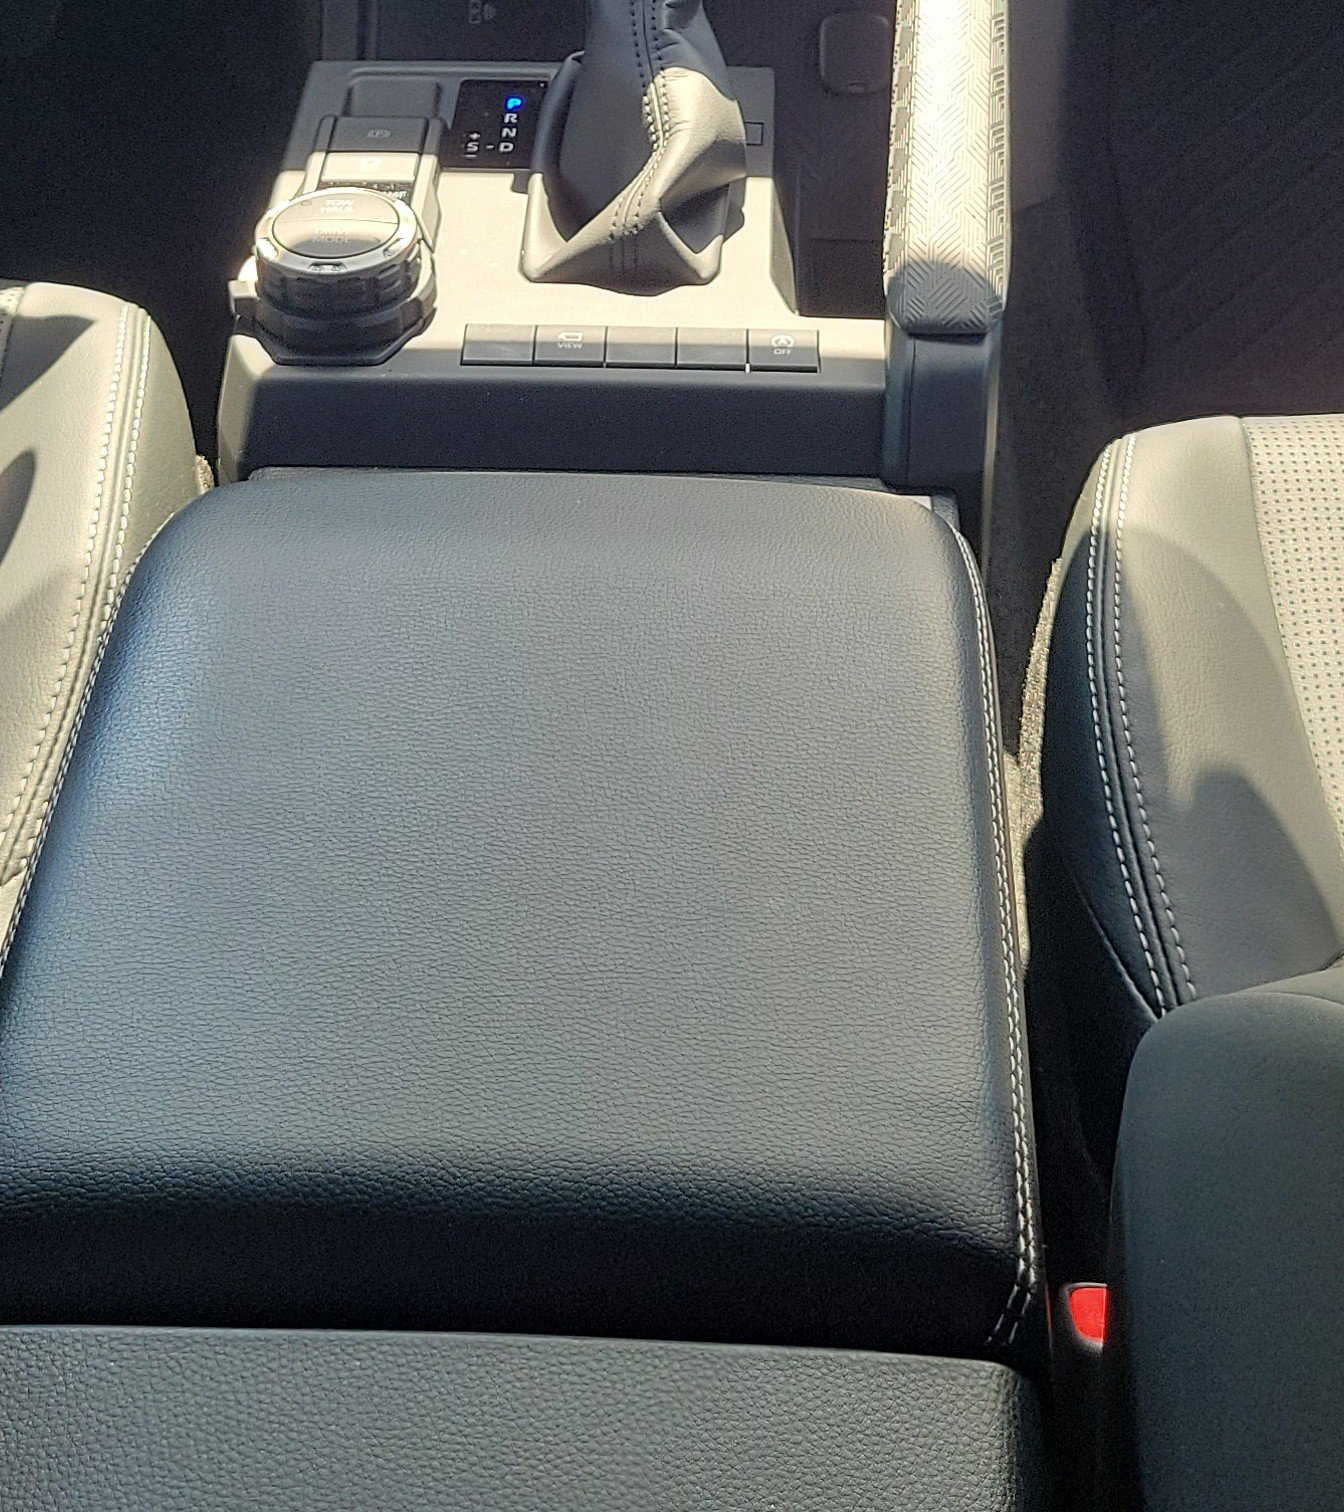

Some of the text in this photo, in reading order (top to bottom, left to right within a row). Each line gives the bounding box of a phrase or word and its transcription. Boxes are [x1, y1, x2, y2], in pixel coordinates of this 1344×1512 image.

[506, 97, 523, 110] P
[503, 112, 518, 125] R
[501, 127, 517, 139] N
[465, 141, 514, 153] S D
[556, 340, 583, 350] VIEW
[772, 347, 794, 357] OFF
